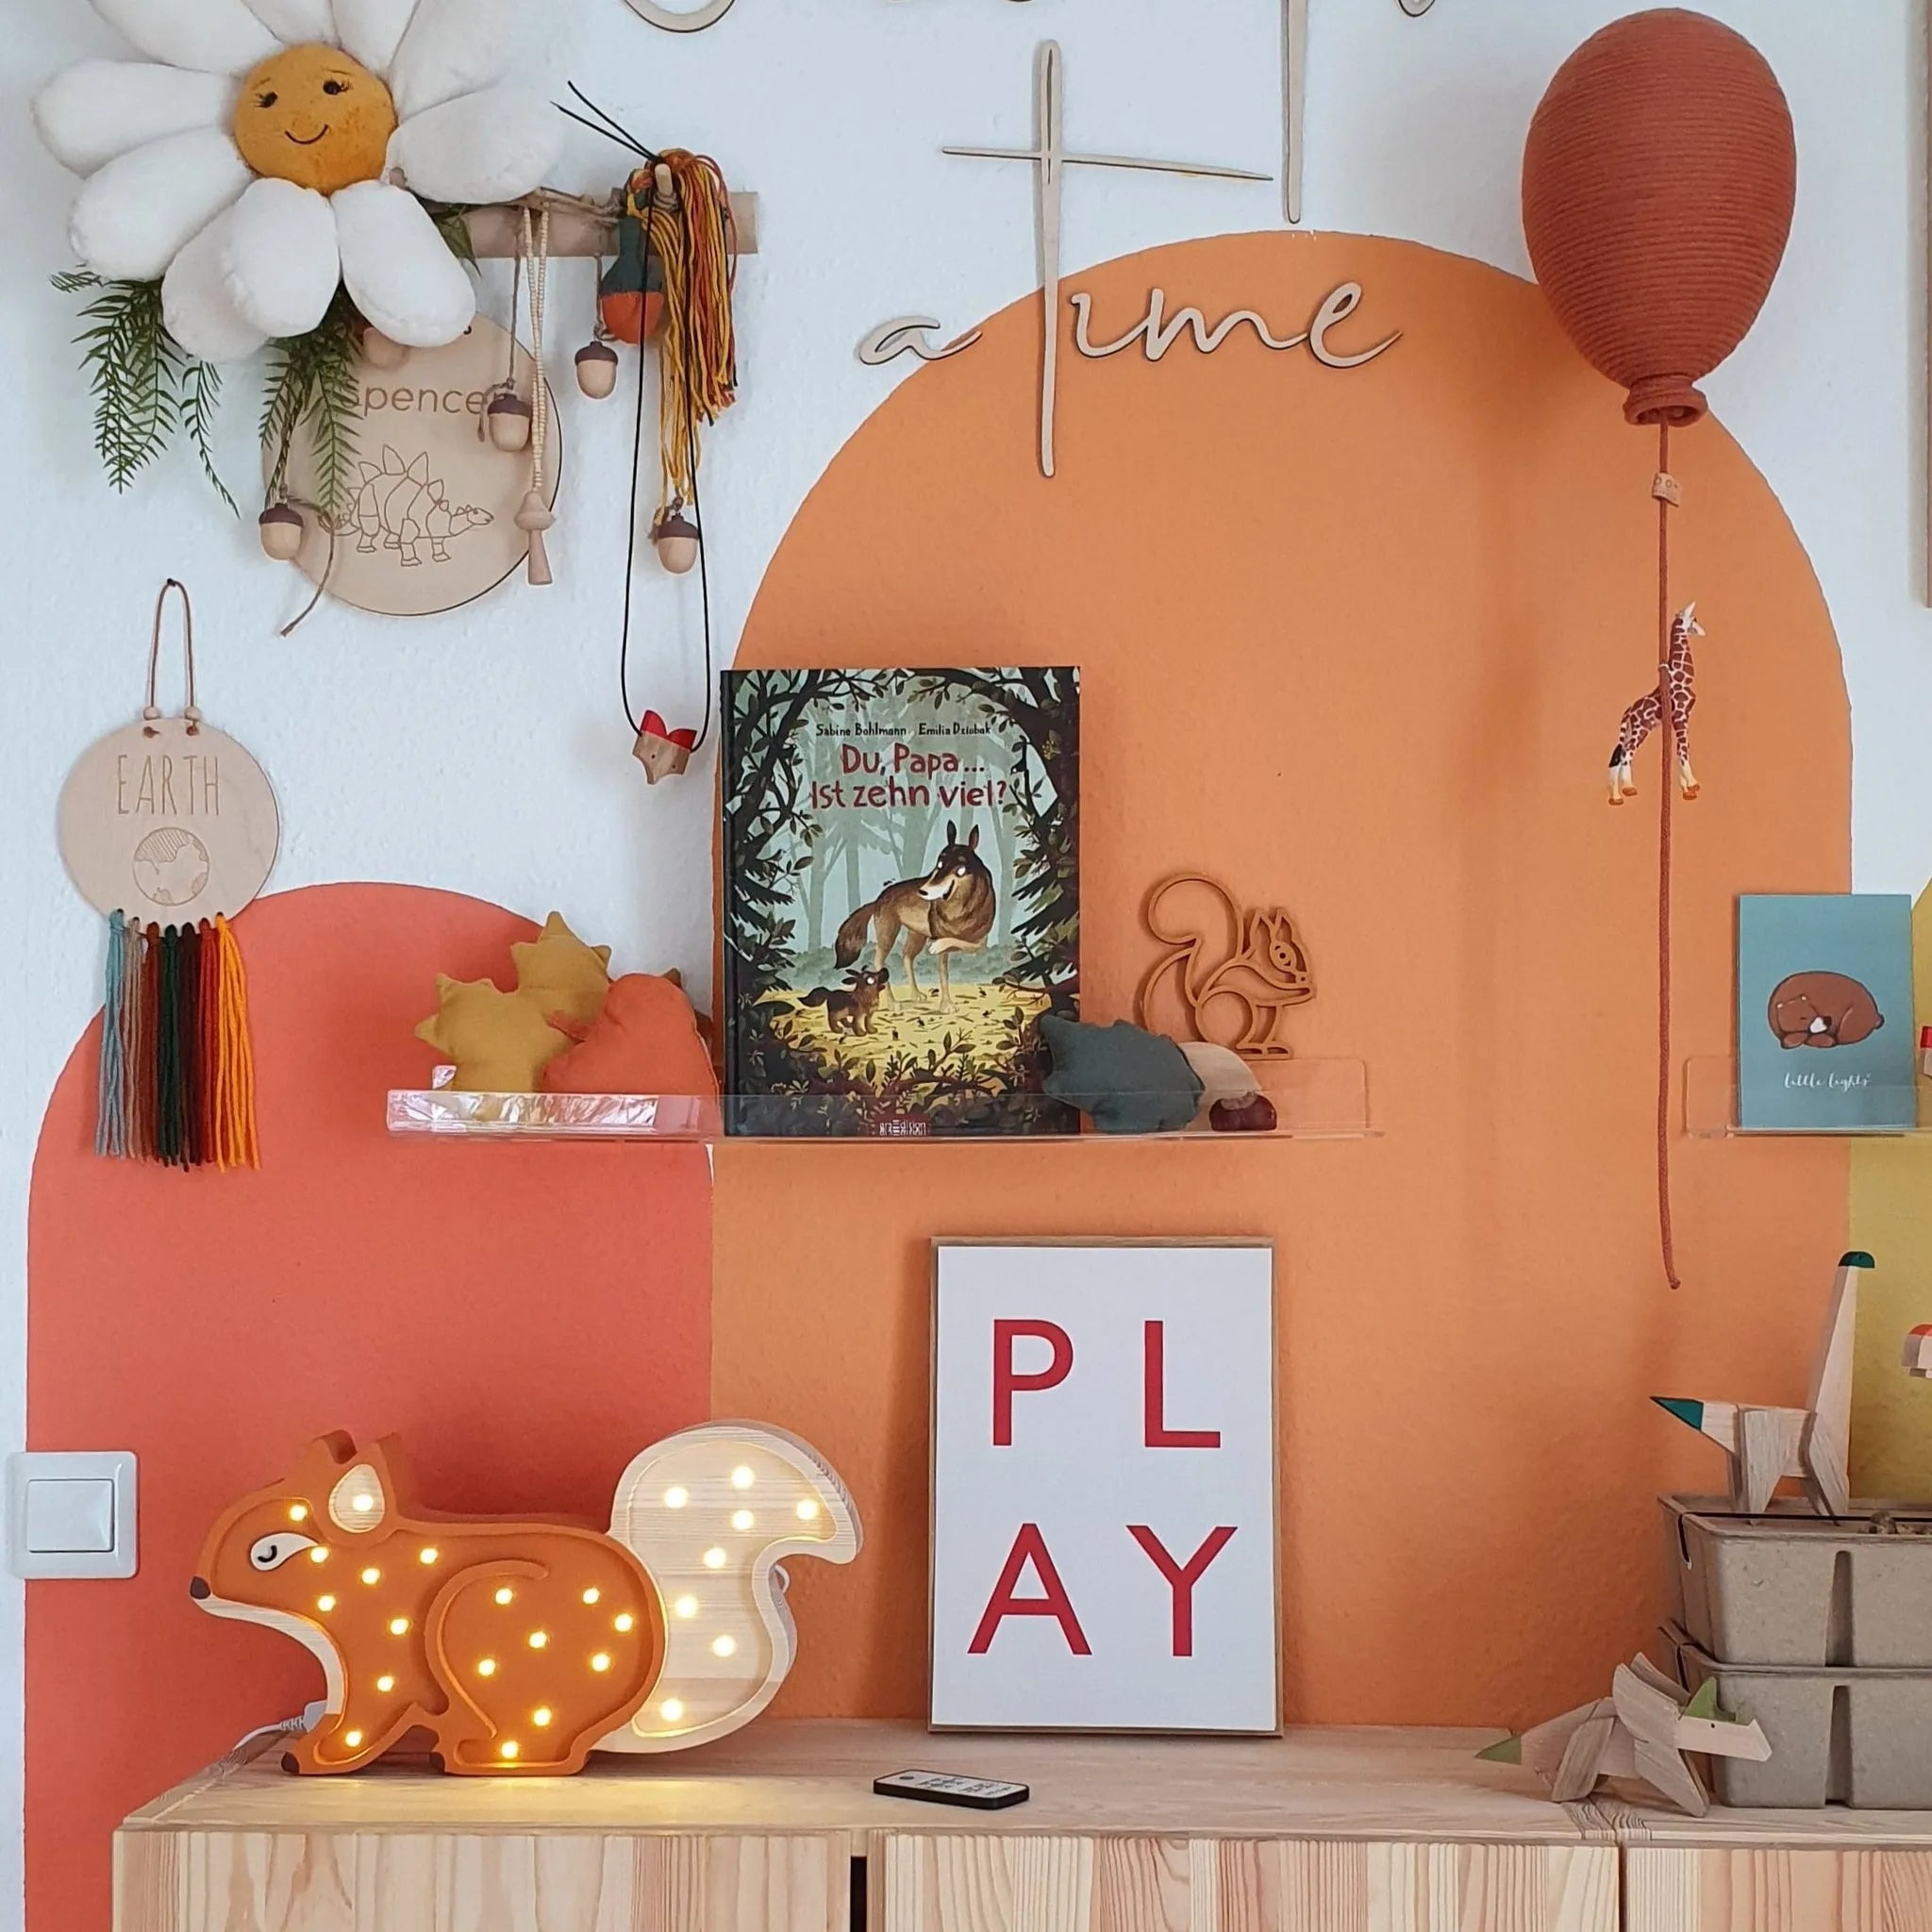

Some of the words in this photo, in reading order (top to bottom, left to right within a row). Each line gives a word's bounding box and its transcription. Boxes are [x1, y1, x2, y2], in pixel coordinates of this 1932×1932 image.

[816, 724, 852, 737] Sabine
[855, 722, 907, 736] Bohlmann
[918, 723, 951, 735] Emilia
[841, 743, 886, 775] Du,
[894, 742, 985, 780] Papa...
[118, 754, 220, 816] EARTH
[811, 780, 846, 808] Ist
[853, 775, 930, 808] zehn
[939, 780, 1007, 808] viel?
[1784, 1072, 1823, 1089] little
